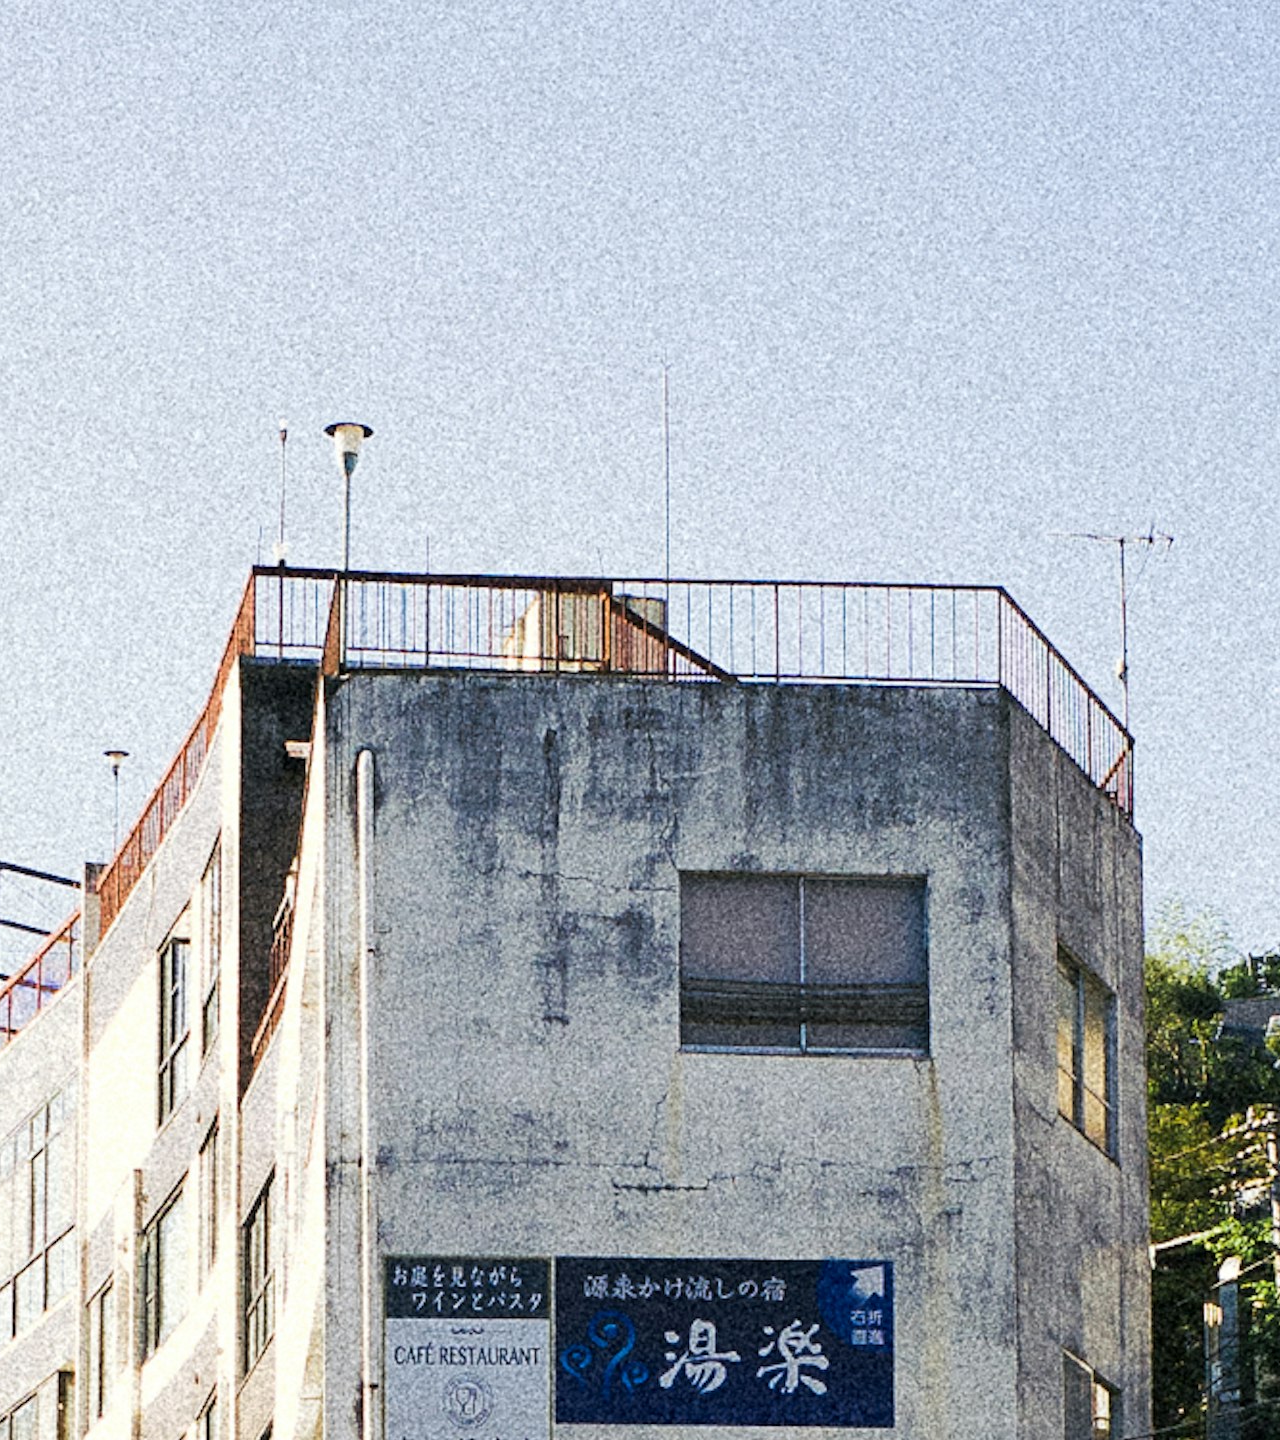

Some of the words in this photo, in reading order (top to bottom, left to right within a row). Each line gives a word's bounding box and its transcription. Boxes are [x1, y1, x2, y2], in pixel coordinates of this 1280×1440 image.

[392, 1263, 523, 1288] お庭を見ながら
[583, 1273, 787, 1302] 源泉かけ流しの宿
[411, 1290, 543, 1313] ワインとパスタ
[394, 1341, 434, 1365] CAFÉ
[439, 1345, 540, 1365] RESTAURANT
[659, 1317, 830, 1395] 湯楽
